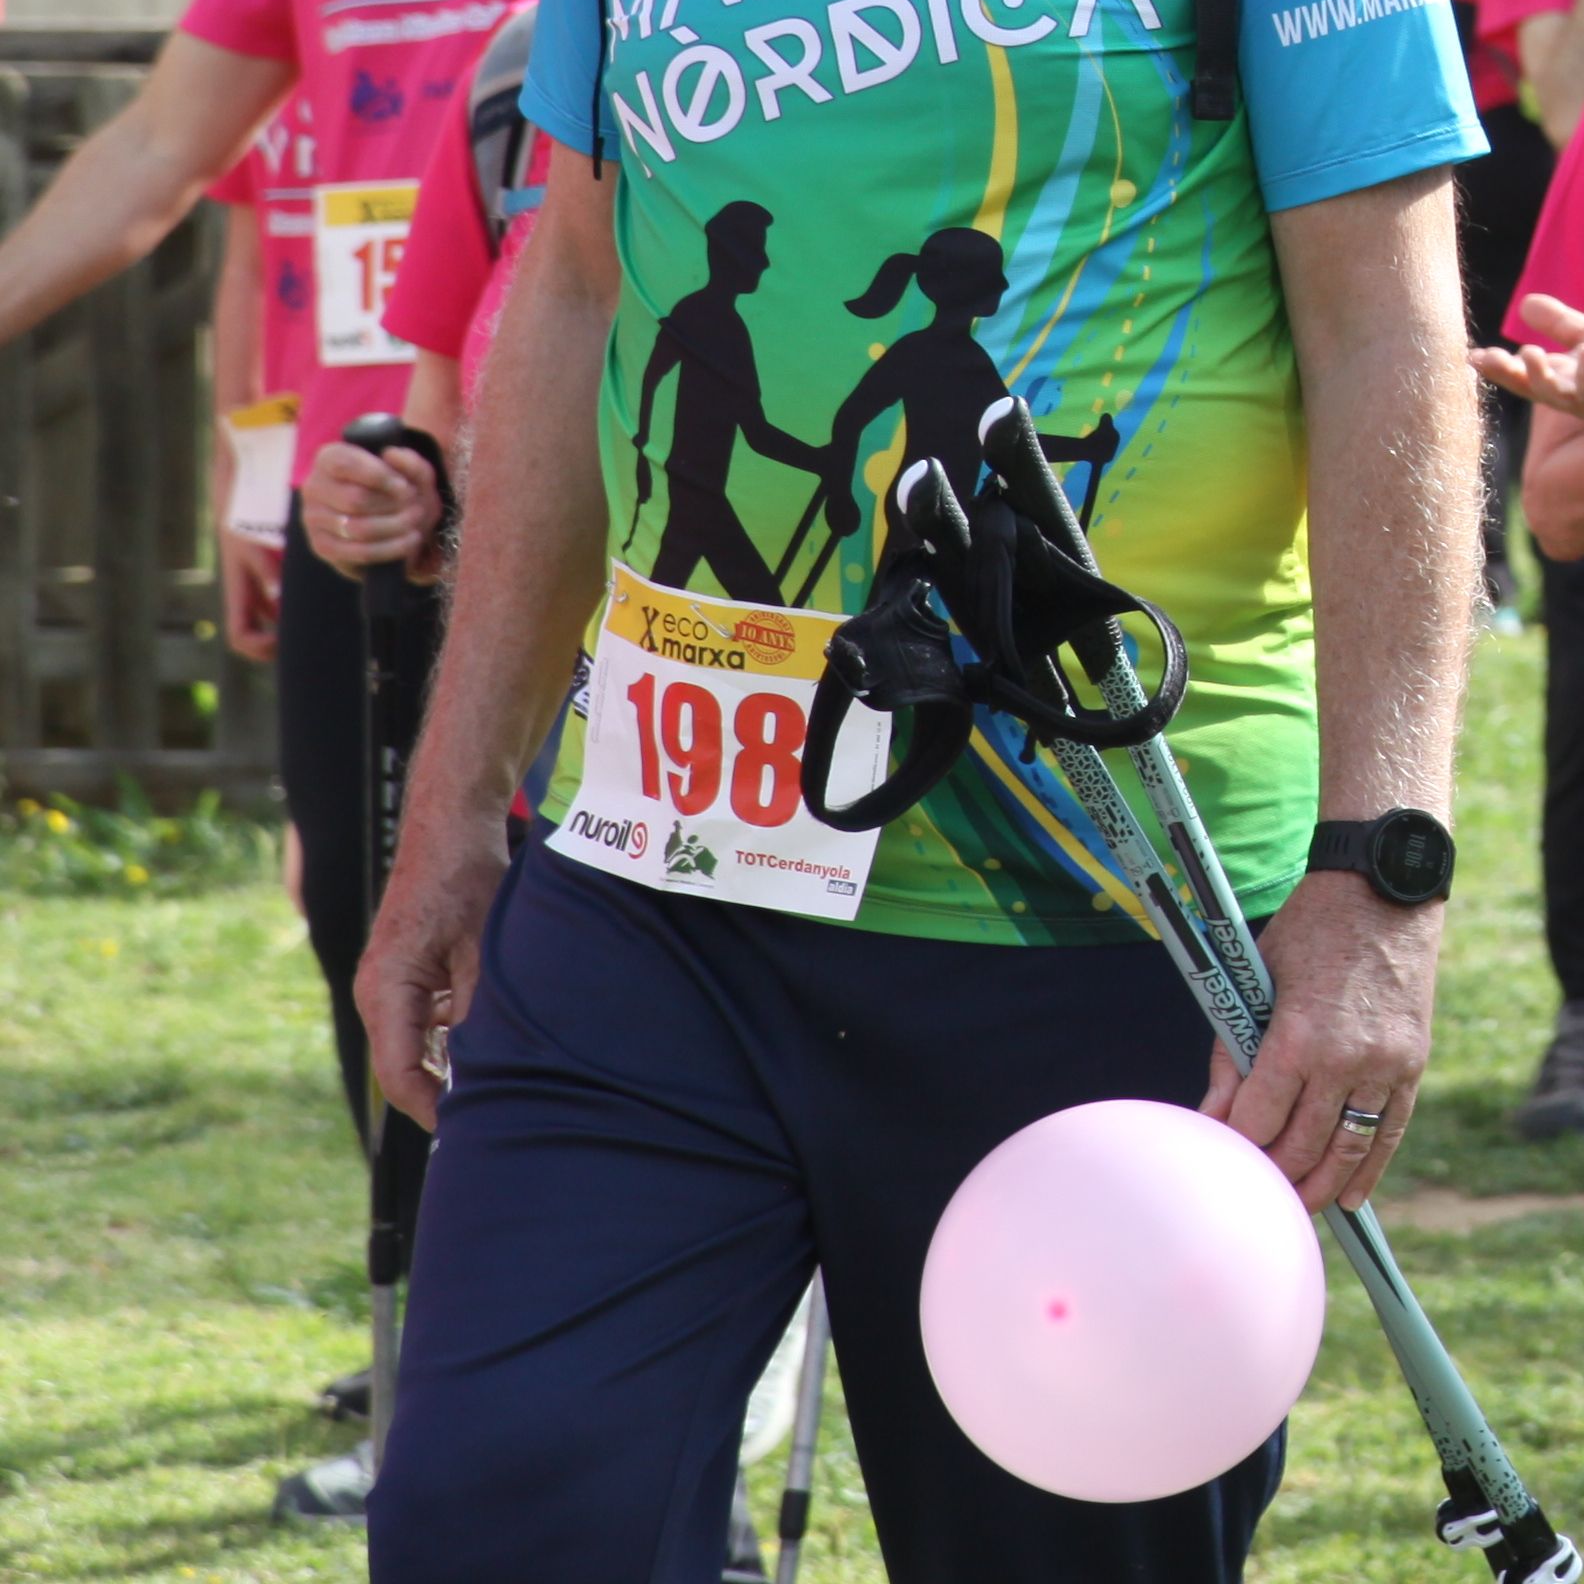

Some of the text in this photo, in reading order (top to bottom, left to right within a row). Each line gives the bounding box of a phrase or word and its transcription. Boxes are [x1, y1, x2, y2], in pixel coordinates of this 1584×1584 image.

[662, 612, 709, 642] eco
[661, 636, 746, 671] marxa
[627, 672, 808, 829] 198
[568, 809, 632, 853] nuroil
[1189, 965, 1264, 1067] ewfeel
